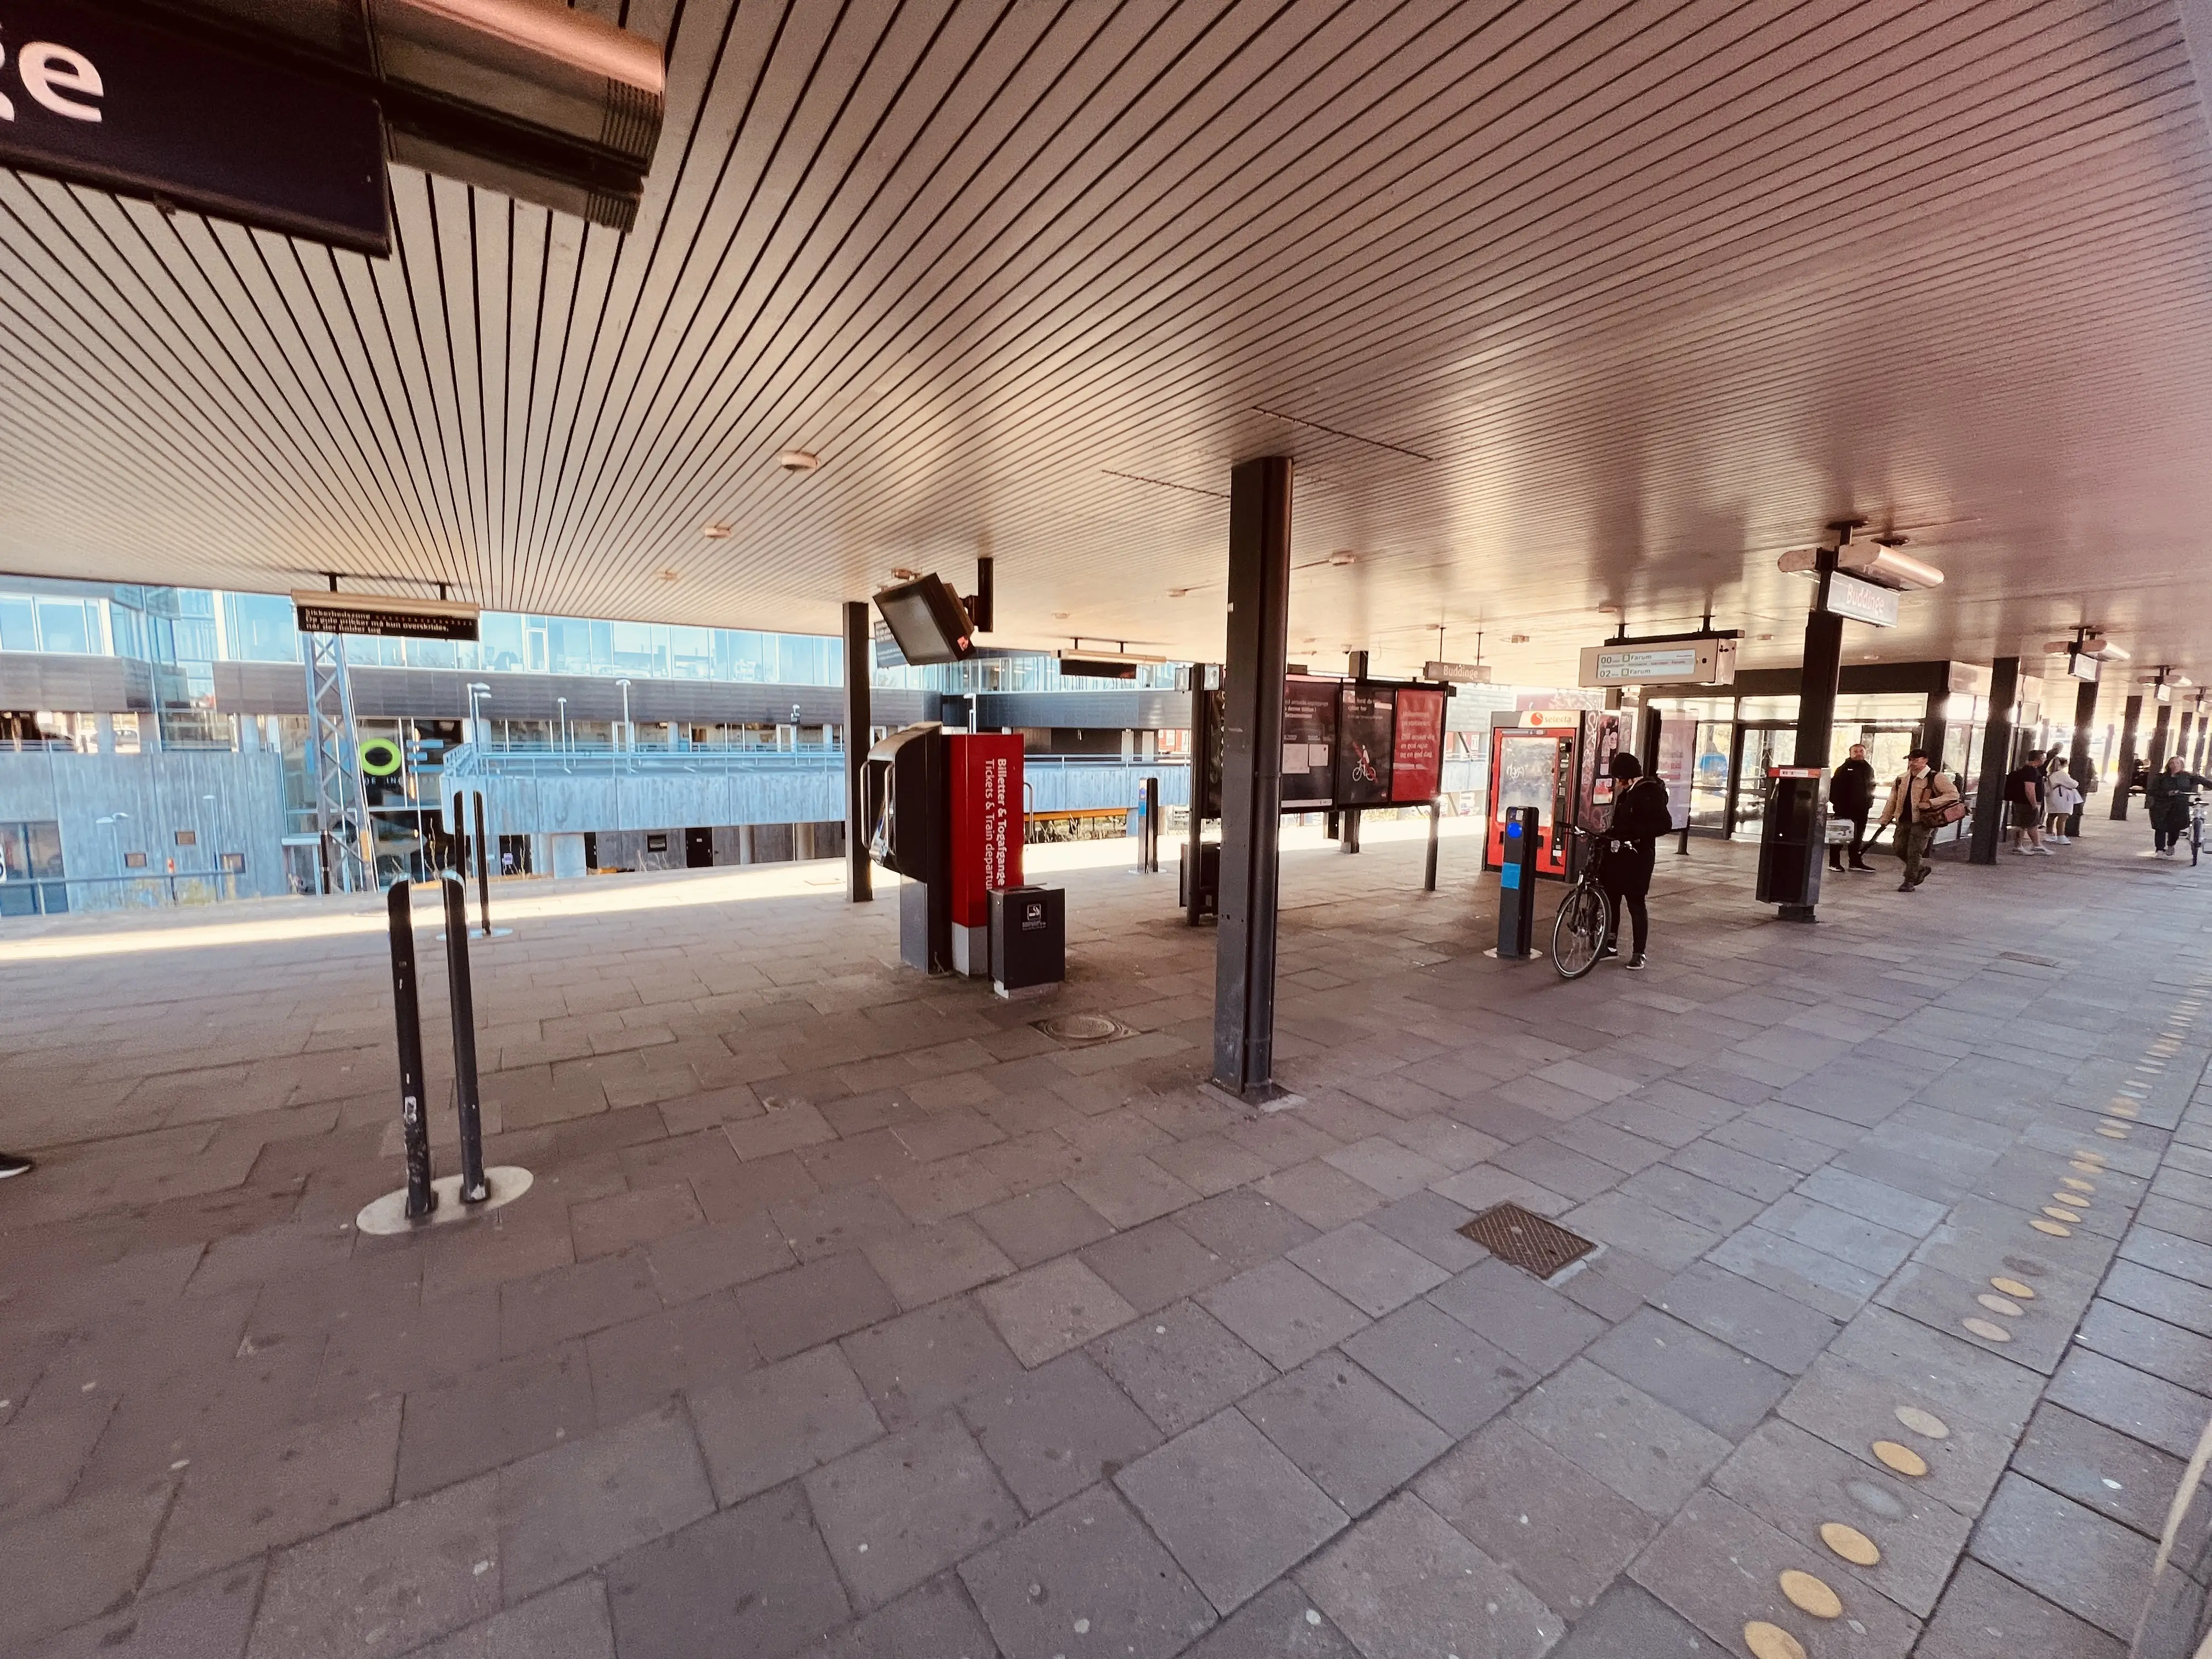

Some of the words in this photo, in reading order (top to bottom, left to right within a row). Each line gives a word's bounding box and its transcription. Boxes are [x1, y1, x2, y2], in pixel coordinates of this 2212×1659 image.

[0, 25, 104, 123] e
[1846, 583, 1884, 616] Buddinge
[1443, 664, 1479, 680] Buddinge
[985, 759, 995, 799] Tickets
[997, 758, 1007, 806] Billetter
[985, 801, 995, 810] &
[997, 808, 1007, 817] &
[985, 812, 995, 841] Train
[996, 819, 1007, 886] Togafgange
